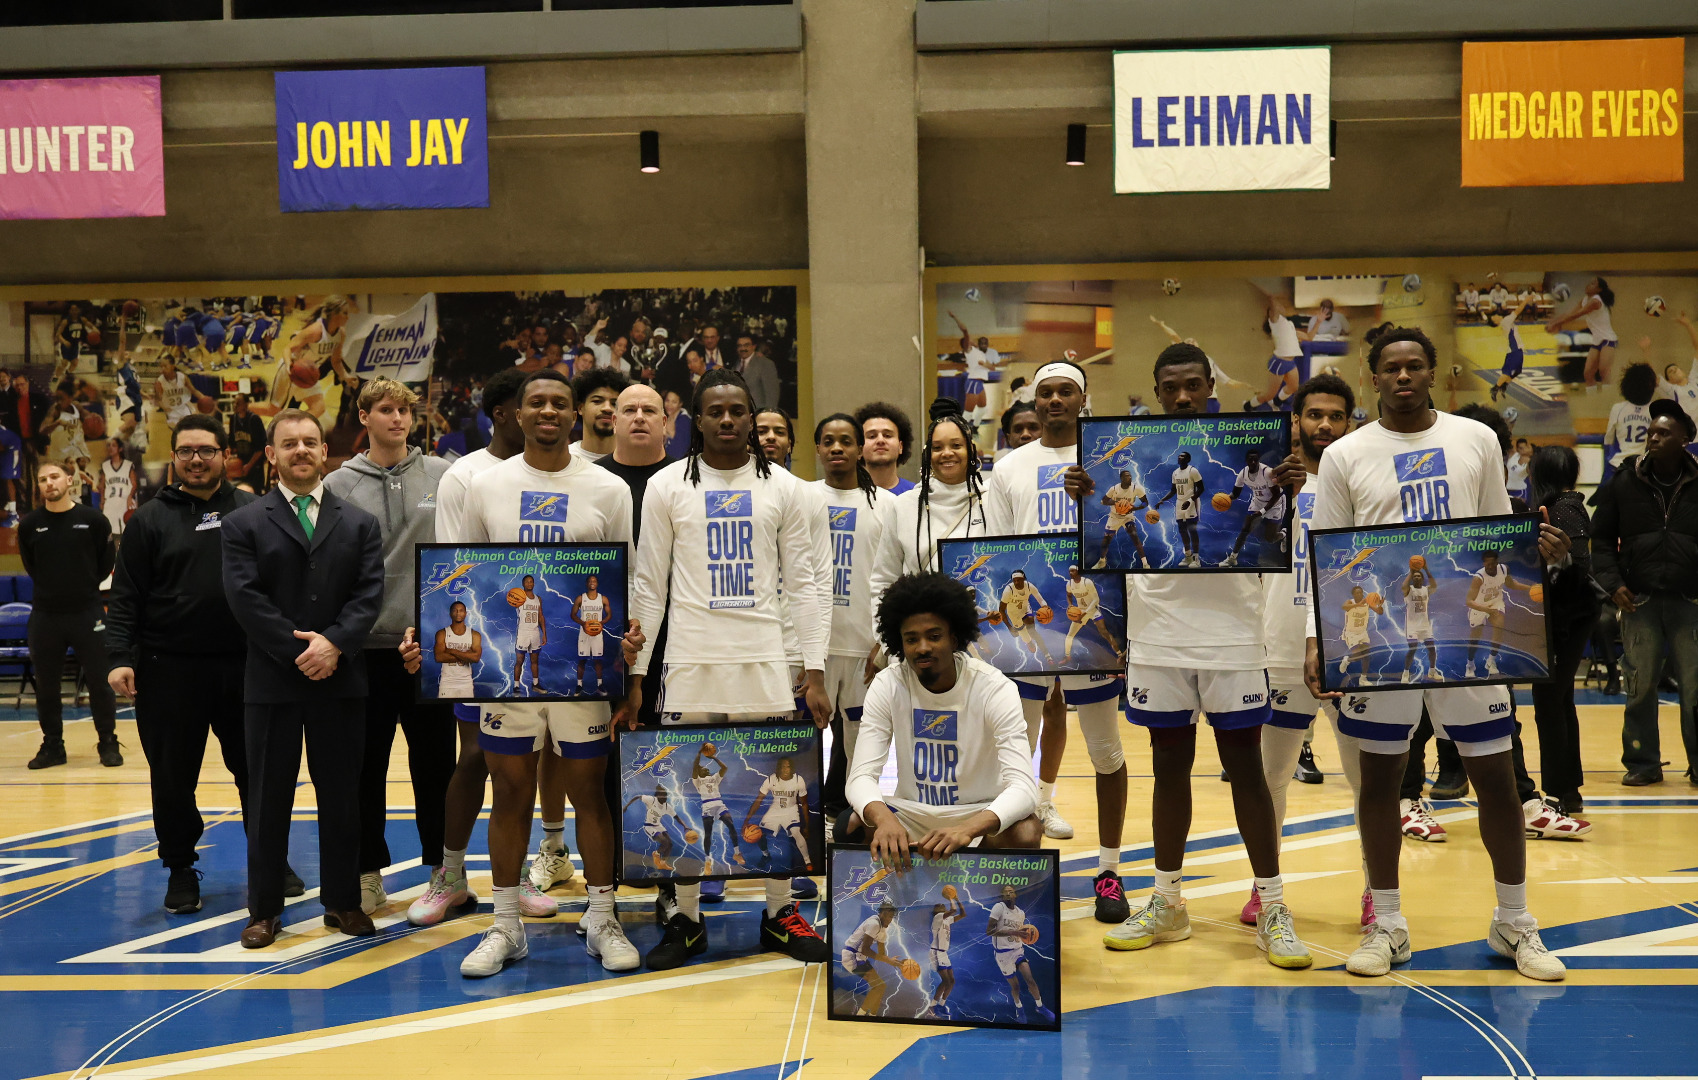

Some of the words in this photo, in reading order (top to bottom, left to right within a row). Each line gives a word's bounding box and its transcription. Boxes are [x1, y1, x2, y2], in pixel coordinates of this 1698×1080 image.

[1132, 93, 1312, 148] LEHMAN
[1469, 91, 1584, 141] MEDGAR
[1592, 88, 1678, 138] EVERS
[293, 120, 391, 169] JOHN
[406, 118, 469, 167] JAY
[1120, 423, 1167, 434] Lehman
[1170, 421, 1214, 435] College
[1217, 419, 1281, 433] Basketball
[1625, 425, 1647, 443] 12
[1178, 435, 1220, 448] Manny
[1223, 434, 1265, 445] Barkor
[1400, 480, 1451, 523] OUR
[707, 521, 753, 560] OUR
[1355, 534, 1406, 546] Lehman
[1411, 528, 1459, 543] College
[1462, 521, 1532, 538] Basketball
[830, 532, 855, 567] UR
[974, 544, 1016, 554] Lehman
[1018, 541, 1056, 553] College
[1426, 542, 1462, 555] Amar
[1467, 539, 1514, 553] Ndiaye
[457, 550, 505, 561] Lehman
[508, 550, 552, 563] College
[555, 550, 617, 561] Basketball
[1044, 553, 1071, 564] Tyler
[500, 564, 537, 575] Daniel
[540, 564, 600, 575] McCollum
[708, 563, 754, 597] TIME
[658, 733, 705, 744] Lehman
[708, 730, 750, 743] College
[753, 727, 814, 741] Basketball
[733, 743, 756, 755] Kofi
[759, 742, 798, 753] Mends
[914, 741, 958, 783] OUR
[916, 782, 959, 806] TIME
[978, 857, 1048, 871] Basketball
[938, 871, 988, 884] Ricardo
[991, 873, 1029, 886] Dixon
